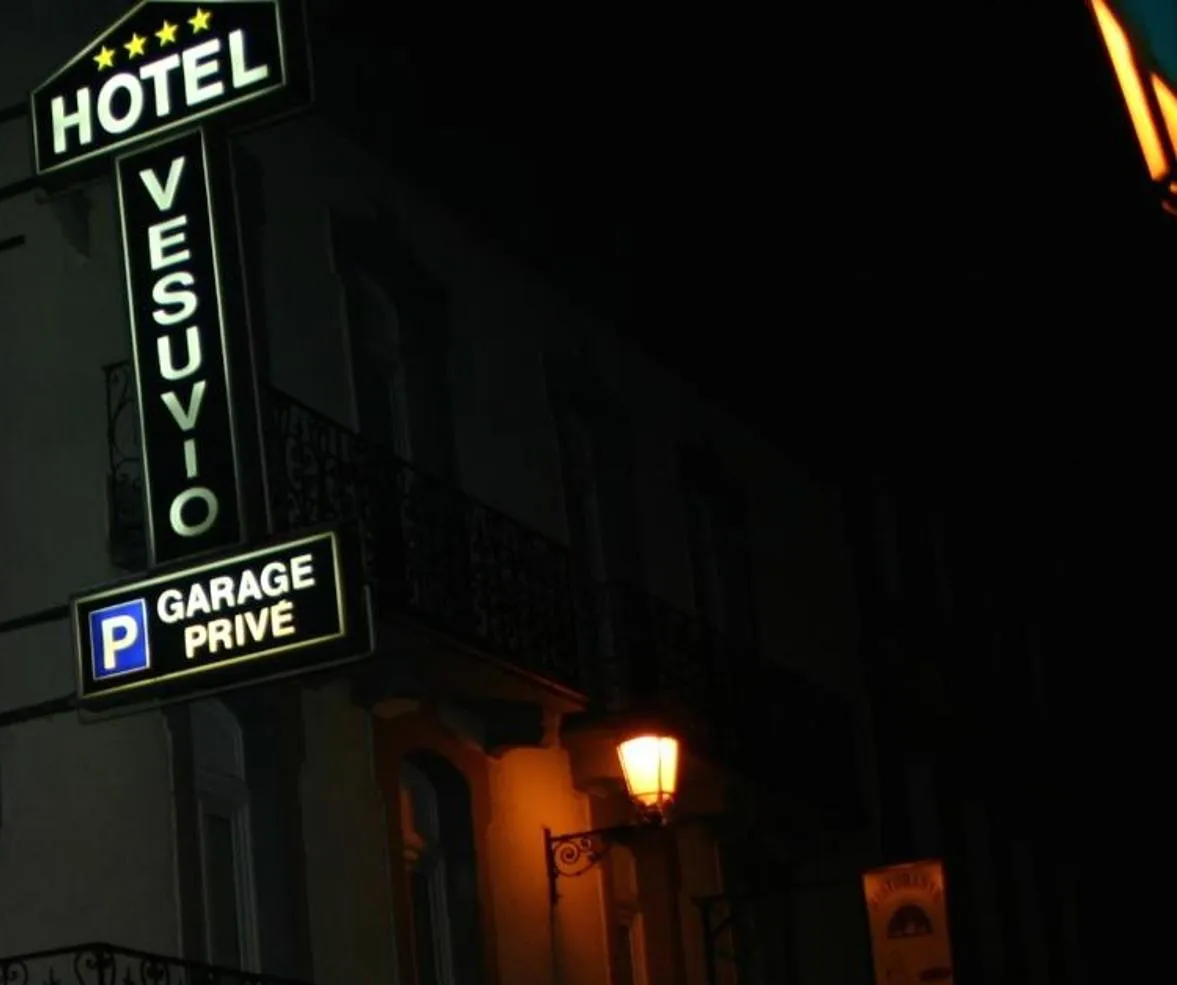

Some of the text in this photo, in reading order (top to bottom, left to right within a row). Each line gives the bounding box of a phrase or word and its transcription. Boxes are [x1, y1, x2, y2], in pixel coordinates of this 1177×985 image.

[51, 29, 269, 154] HOTEL
[139, 156, 218, 537] VESUVIO
[156, 553, 316, 624] GARAGE
[100, 614, 139, 670] P
[184, 600, 296, 659] PRIVÉ
